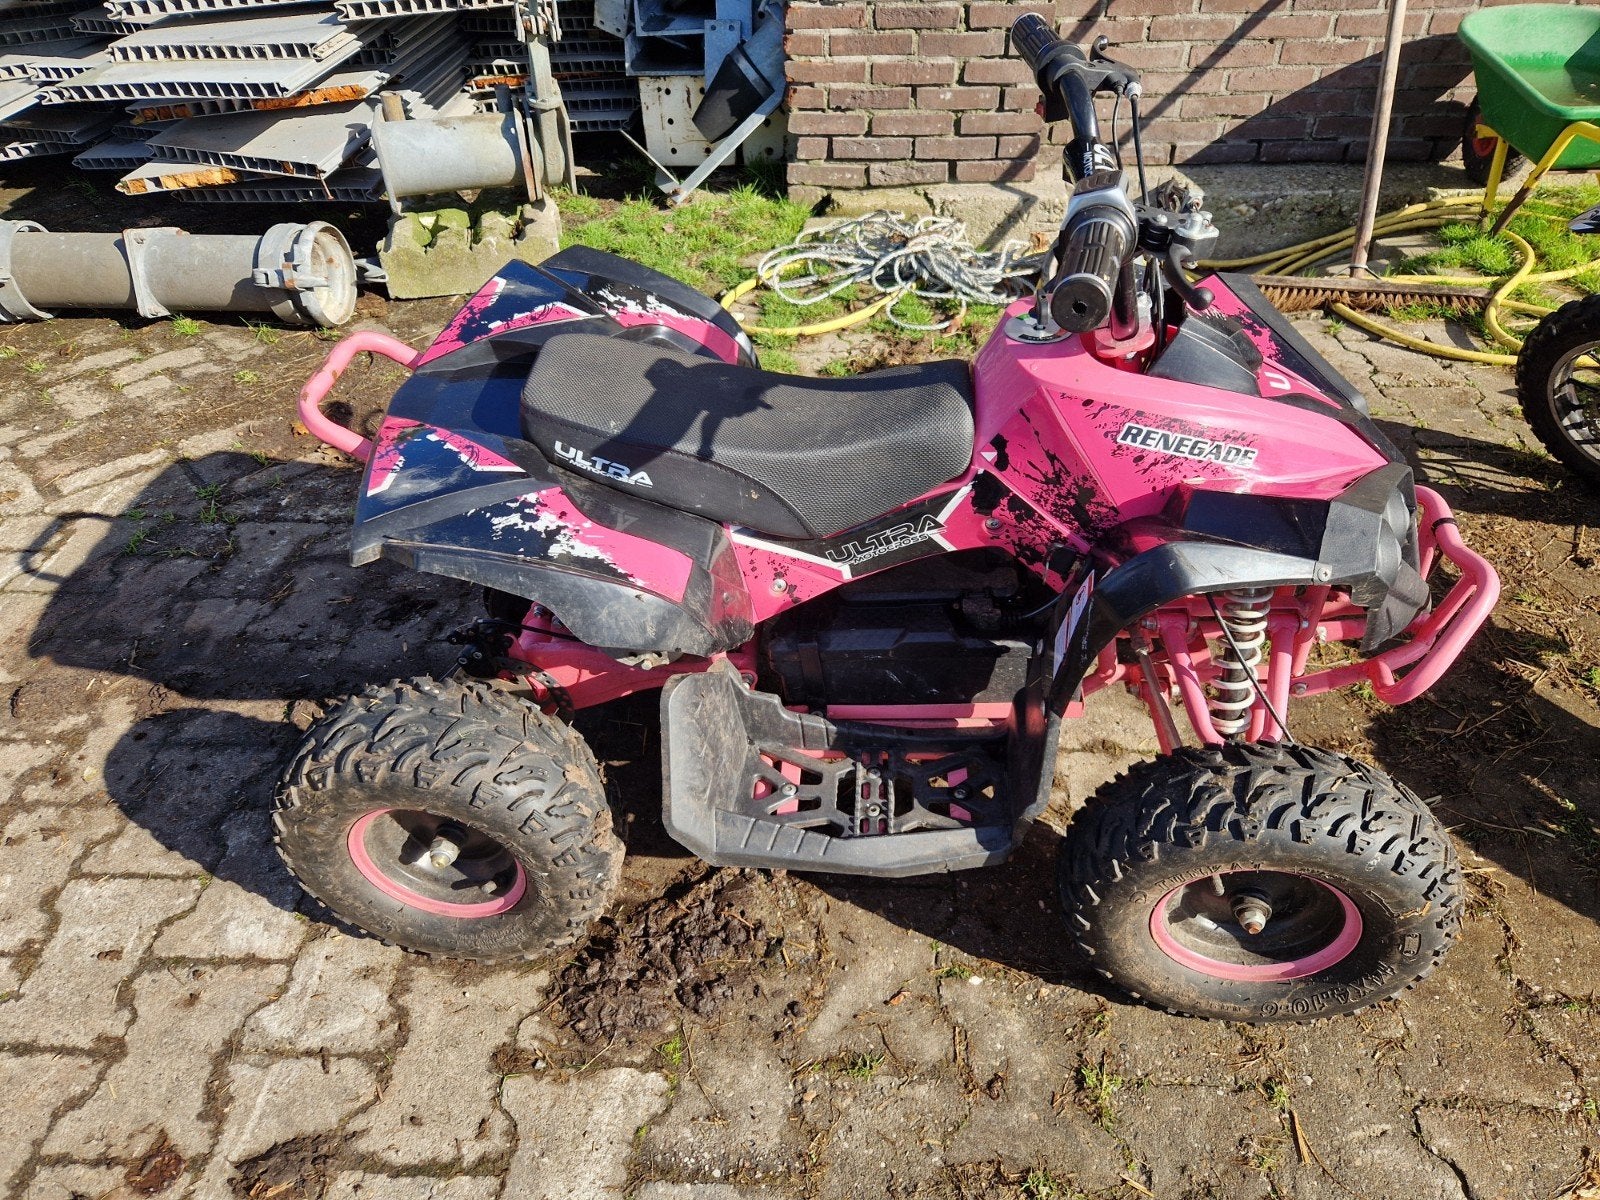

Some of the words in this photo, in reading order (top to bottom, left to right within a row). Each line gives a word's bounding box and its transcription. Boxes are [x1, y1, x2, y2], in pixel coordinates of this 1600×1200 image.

[555, 440, 653, 486] ULTRA
[1120, 425, 1256, 467] RENEGADE
[826, 515, 947, 563] ULTRA
[853, 533, 928, 565] MOTOCROSS
